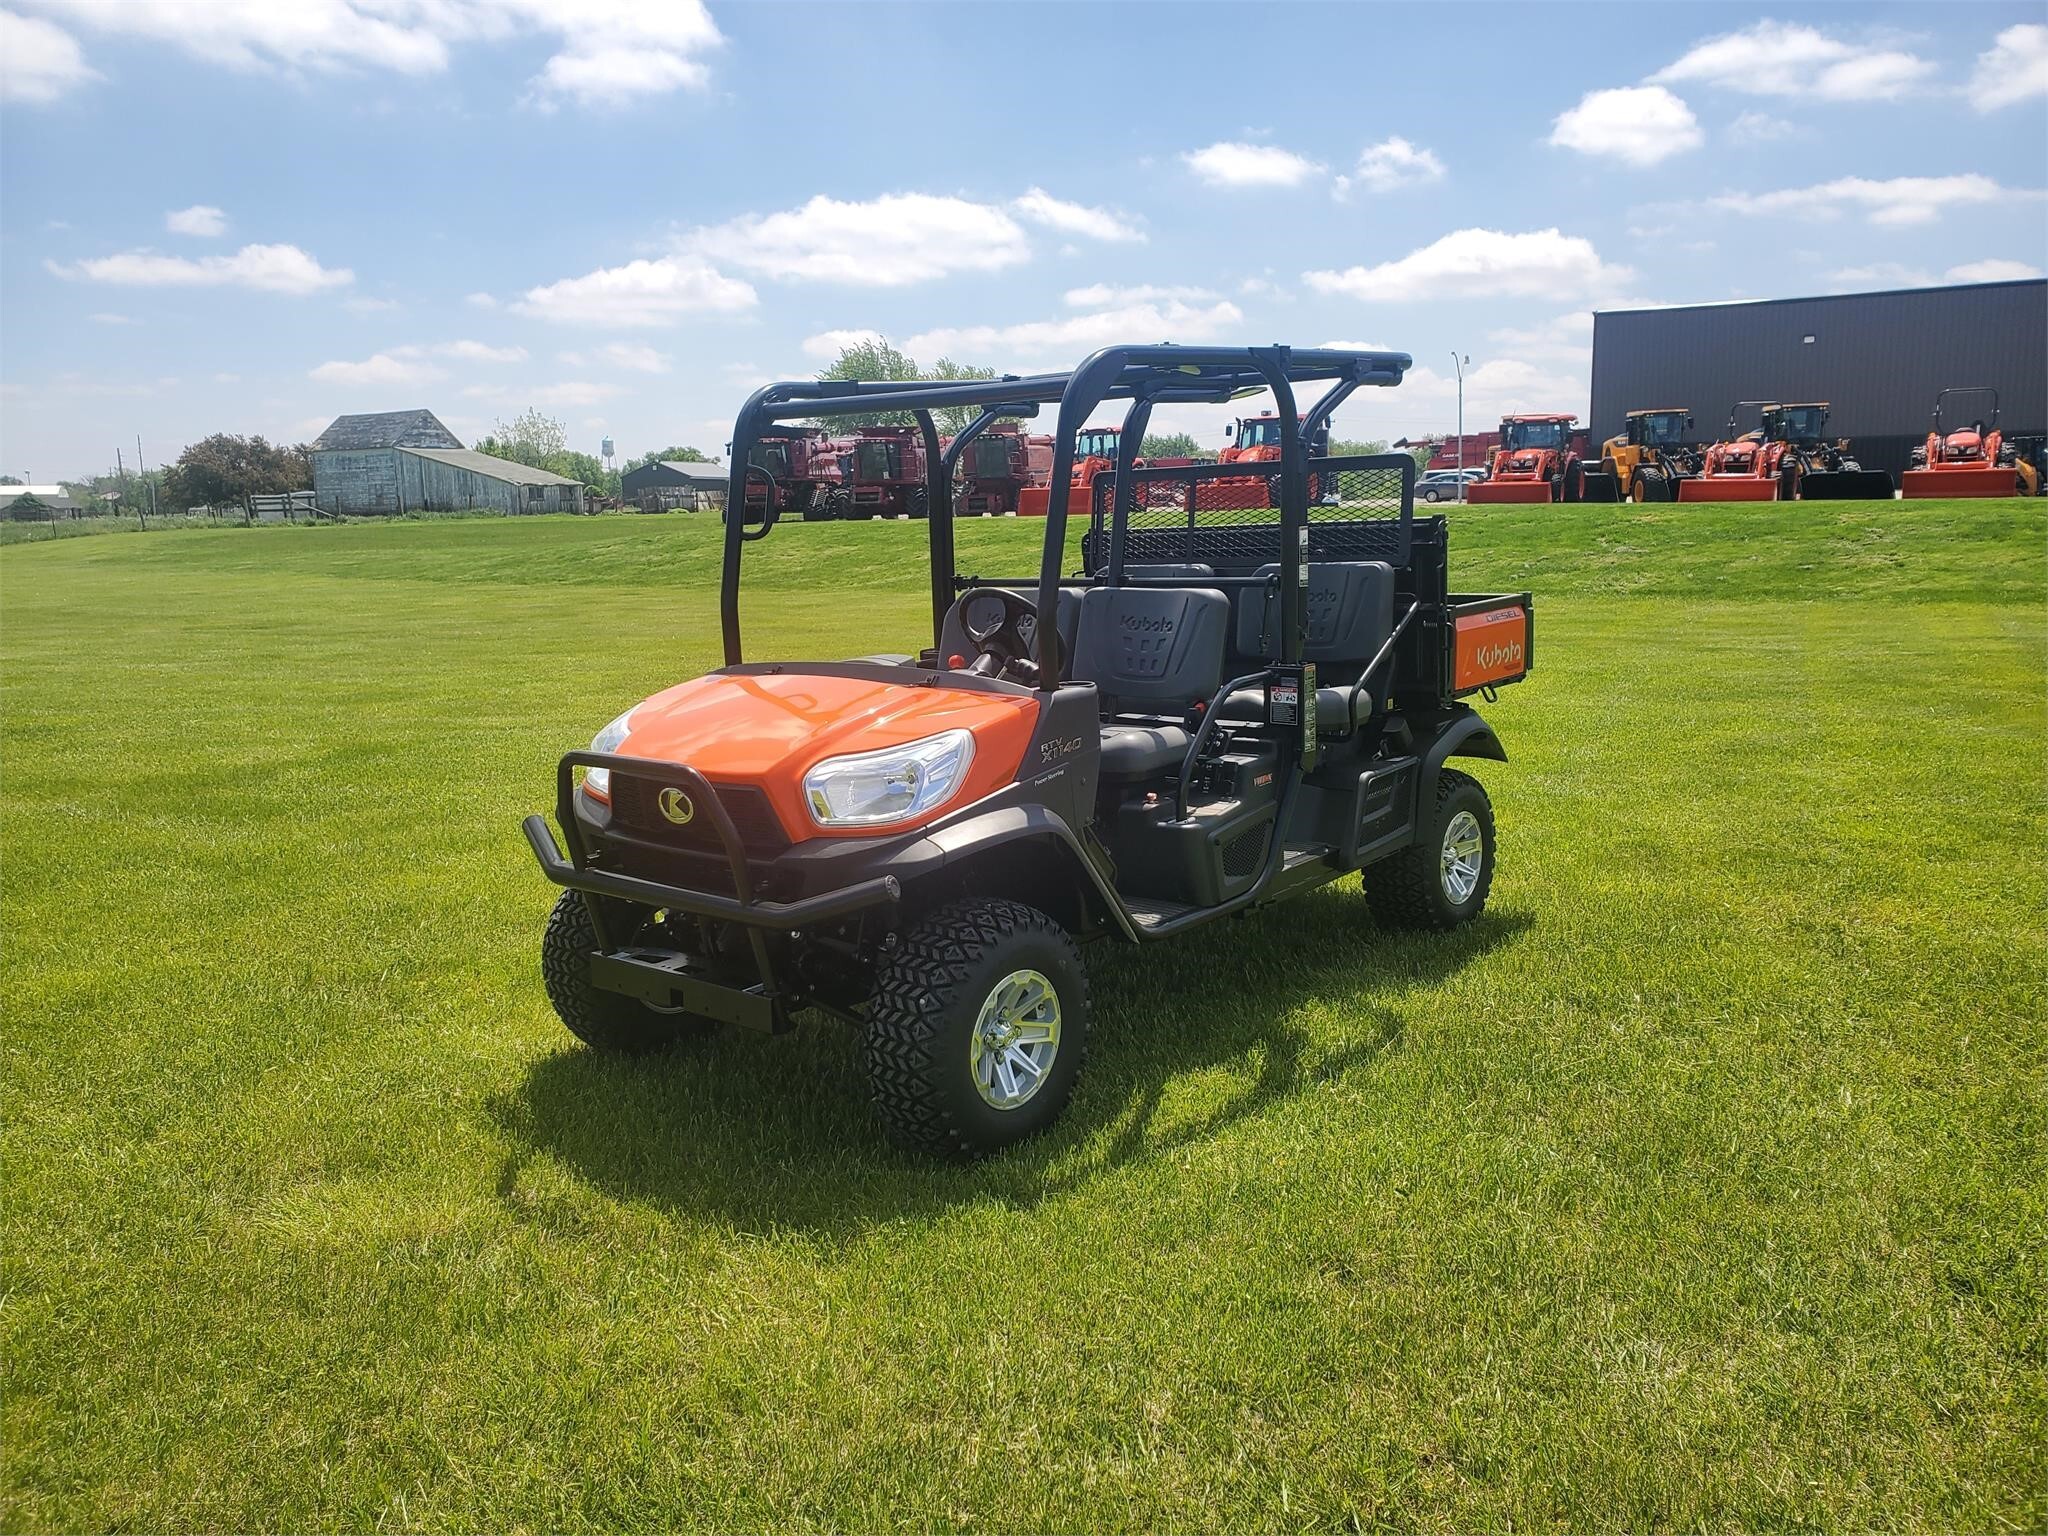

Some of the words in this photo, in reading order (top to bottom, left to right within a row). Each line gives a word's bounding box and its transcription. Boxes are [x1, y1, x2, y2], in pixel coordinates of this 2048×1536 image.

[1120, 615, 1173, 632] Kubota
[1485, 609, 1520, 622] DIESEL
[1477, 640, 1521, 670] Kubota
[1041, 737, 1063, 752] RTV
[1041, 737, 1082, 763] X1140
